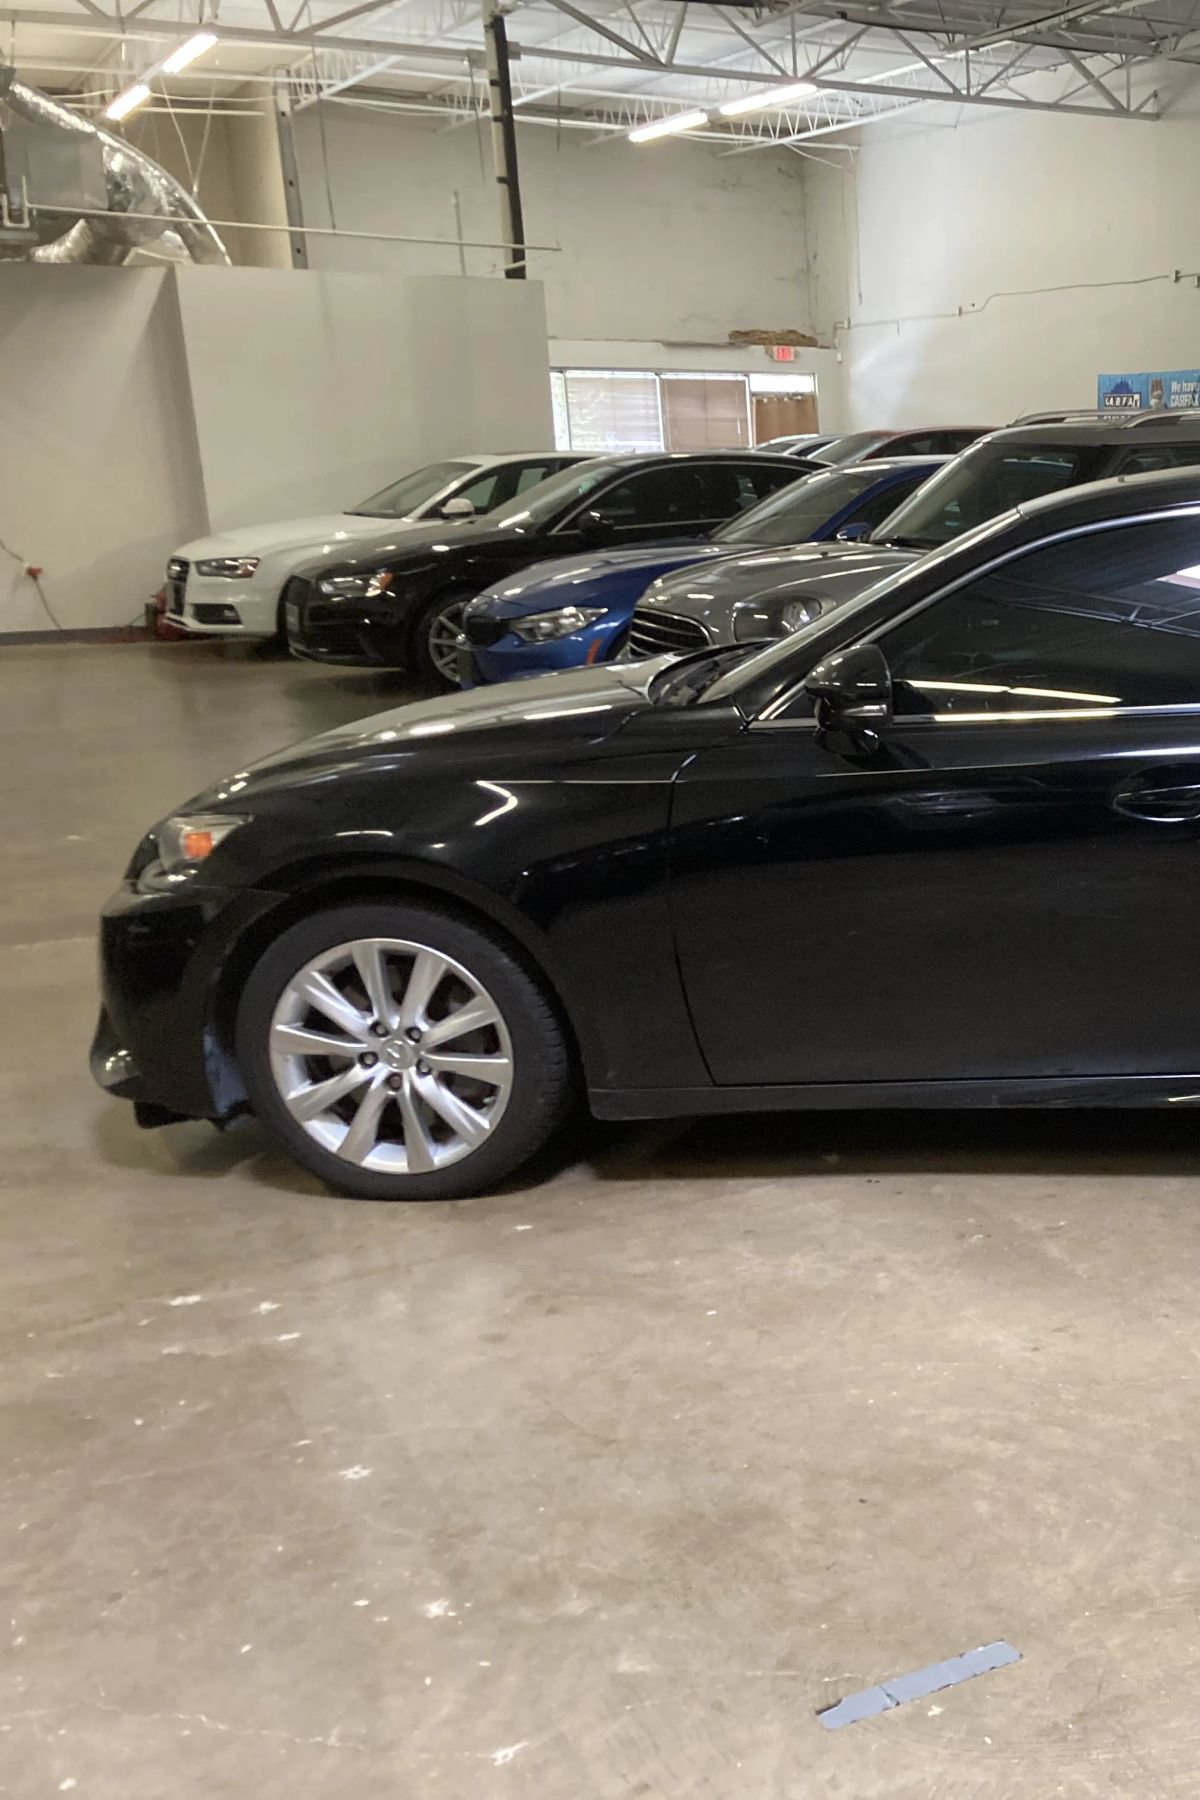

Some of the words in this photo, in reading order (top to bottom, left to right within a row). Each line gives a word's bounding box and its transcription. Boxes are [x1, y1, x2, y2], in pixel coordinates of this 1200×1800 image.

[1171, 381, 1181, 393] We
[1183, 380, 1200, 392] have
[1171, 394, 1200, 407] CARFAX
